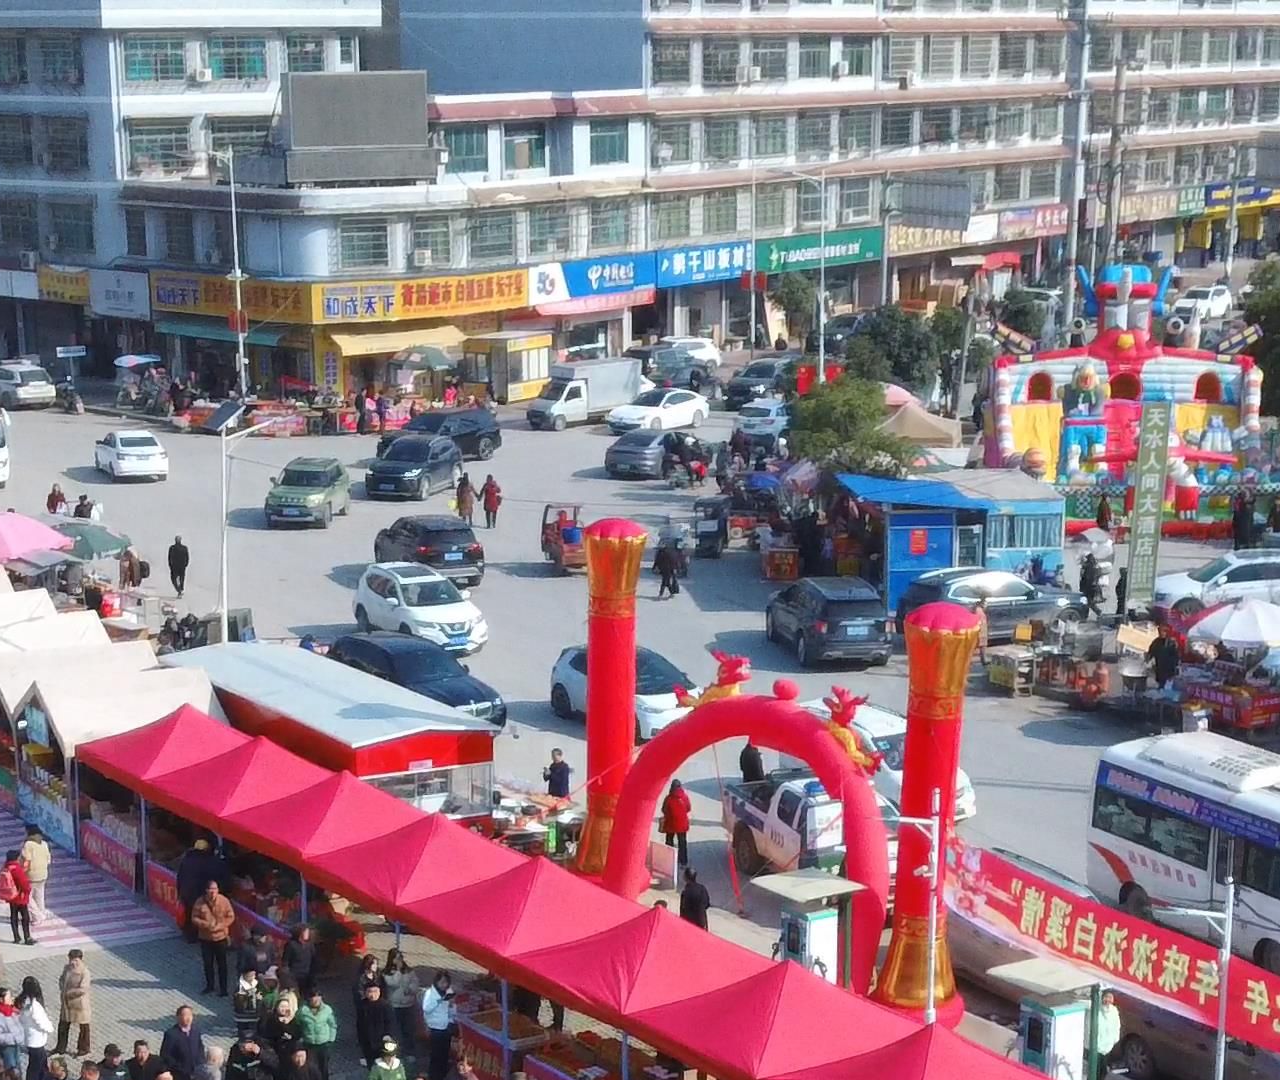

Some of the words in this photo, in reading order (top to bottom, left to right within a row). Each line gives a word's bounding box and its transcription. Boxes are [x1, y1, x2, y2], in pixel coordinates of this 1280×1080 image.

[325, 294, 396, 317] 和成天下
[1134, 408, 1166, 557] 天水人间大酒店
